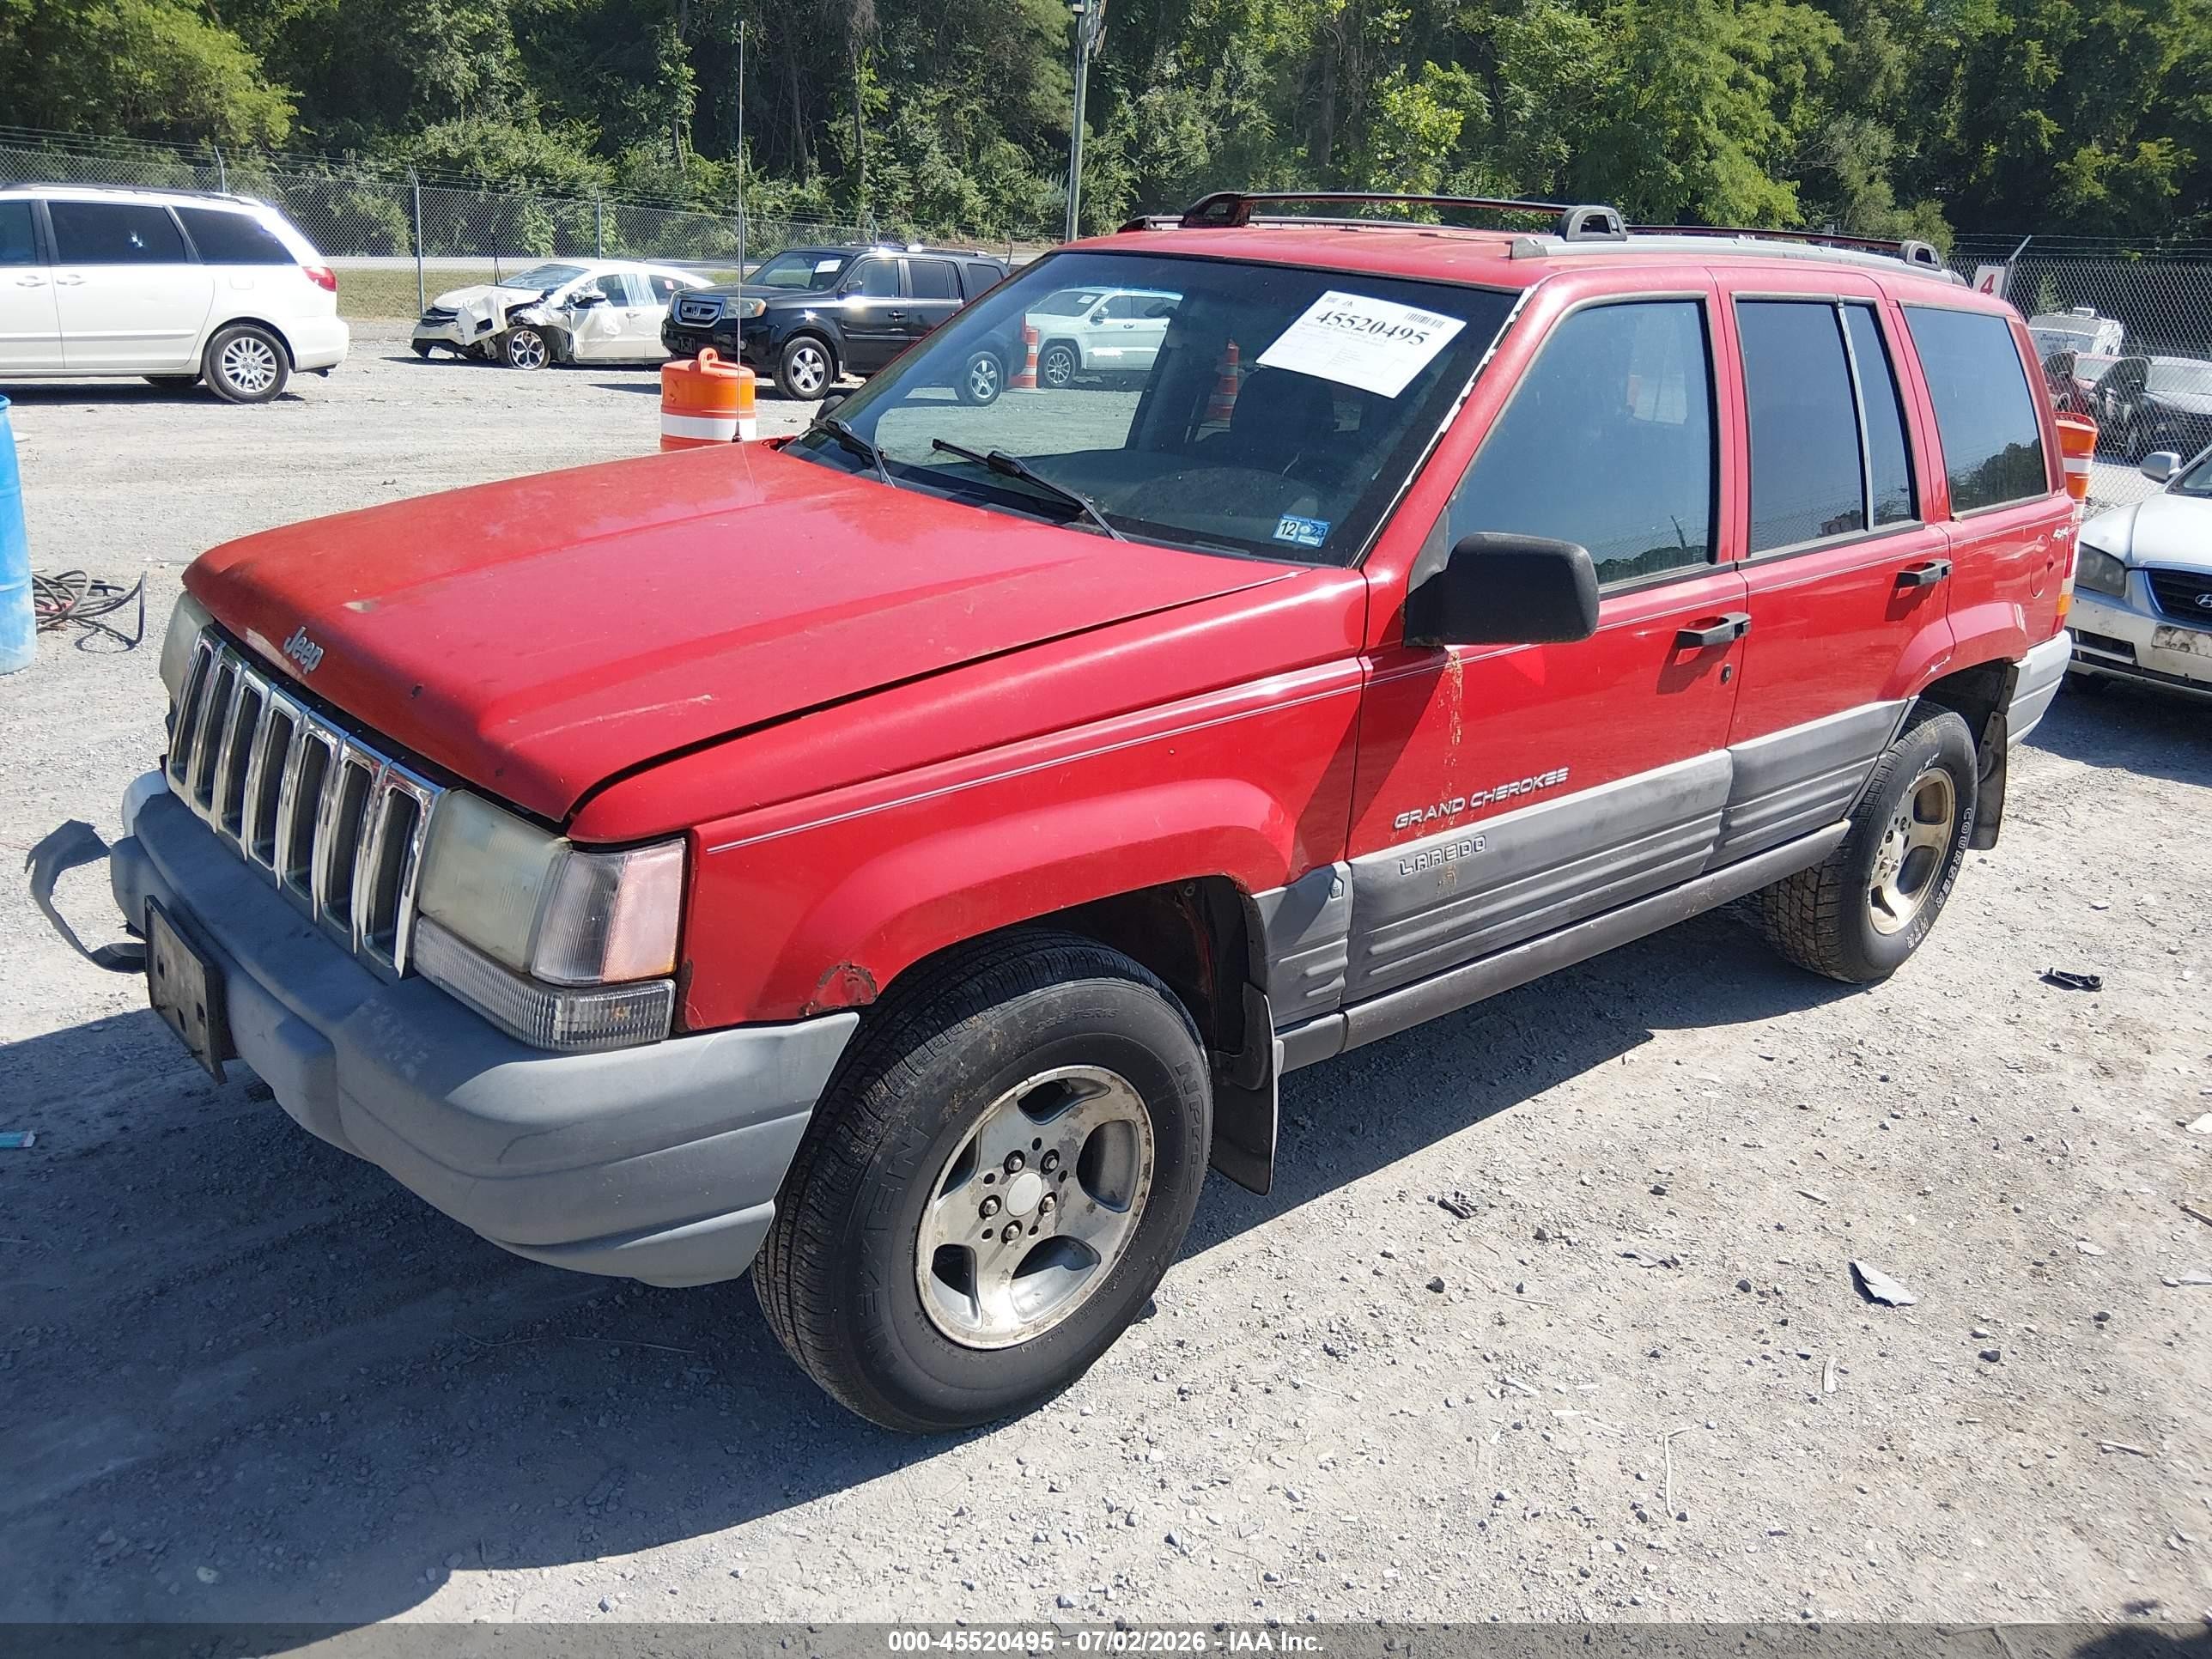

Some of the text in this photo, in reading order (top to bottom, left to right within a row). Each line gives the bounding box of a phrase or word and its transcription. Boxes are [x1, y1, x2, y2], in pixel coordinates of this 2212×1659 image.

[1979, 274, 1994, 295] 4
[1316, 310, 1431, 345] 45520495
[1280, 520, 1297, 537] 12
[283, 626, 324, 675] Jeep
[1394, 766, 1570, 830] GRAND CHEROKEE
[1399, 836, 1486, 876] LAREDO
[1934, 807, 1972, 908] COURSER
